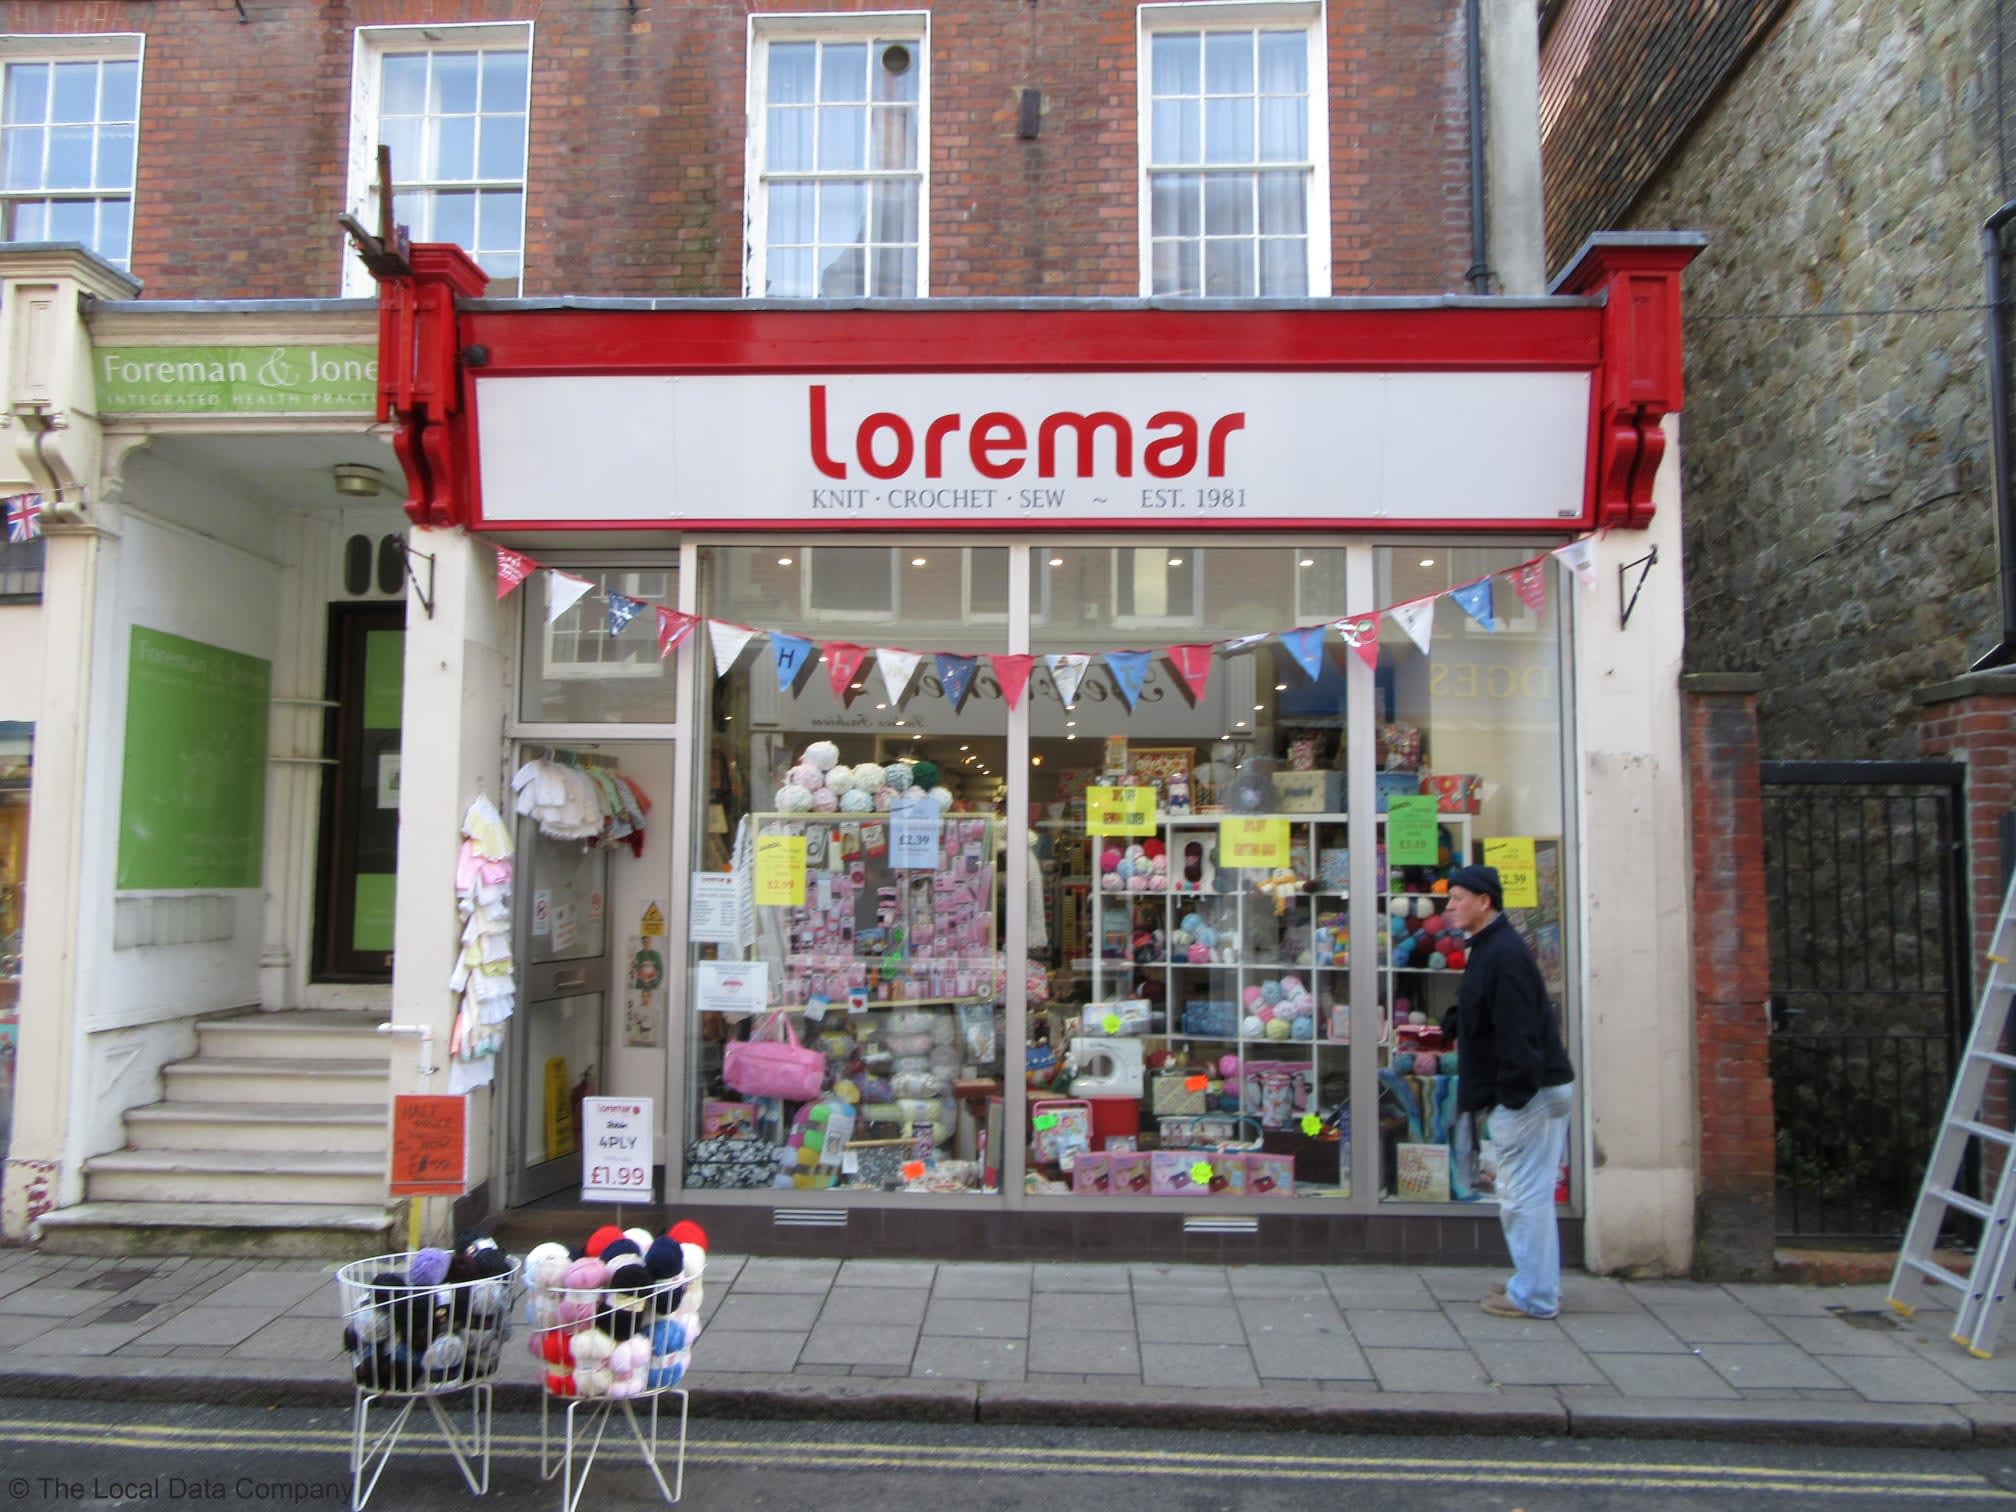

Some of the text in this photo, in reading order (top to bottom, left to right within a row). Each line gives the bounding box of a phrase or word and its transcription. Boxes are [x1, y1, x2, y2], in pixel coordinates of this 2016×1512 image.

[103, 354, 247, 384] Foreman
[257, 347, 300, 387] &
[106, 391, 219, 405] INTEGRATED
[232, 392, 301, 406] HEALTH
[811, 488, 1248, 509] KNIT CROCHET SEW EST. 1981
[591, 1166, 645, 1185] £1.99
